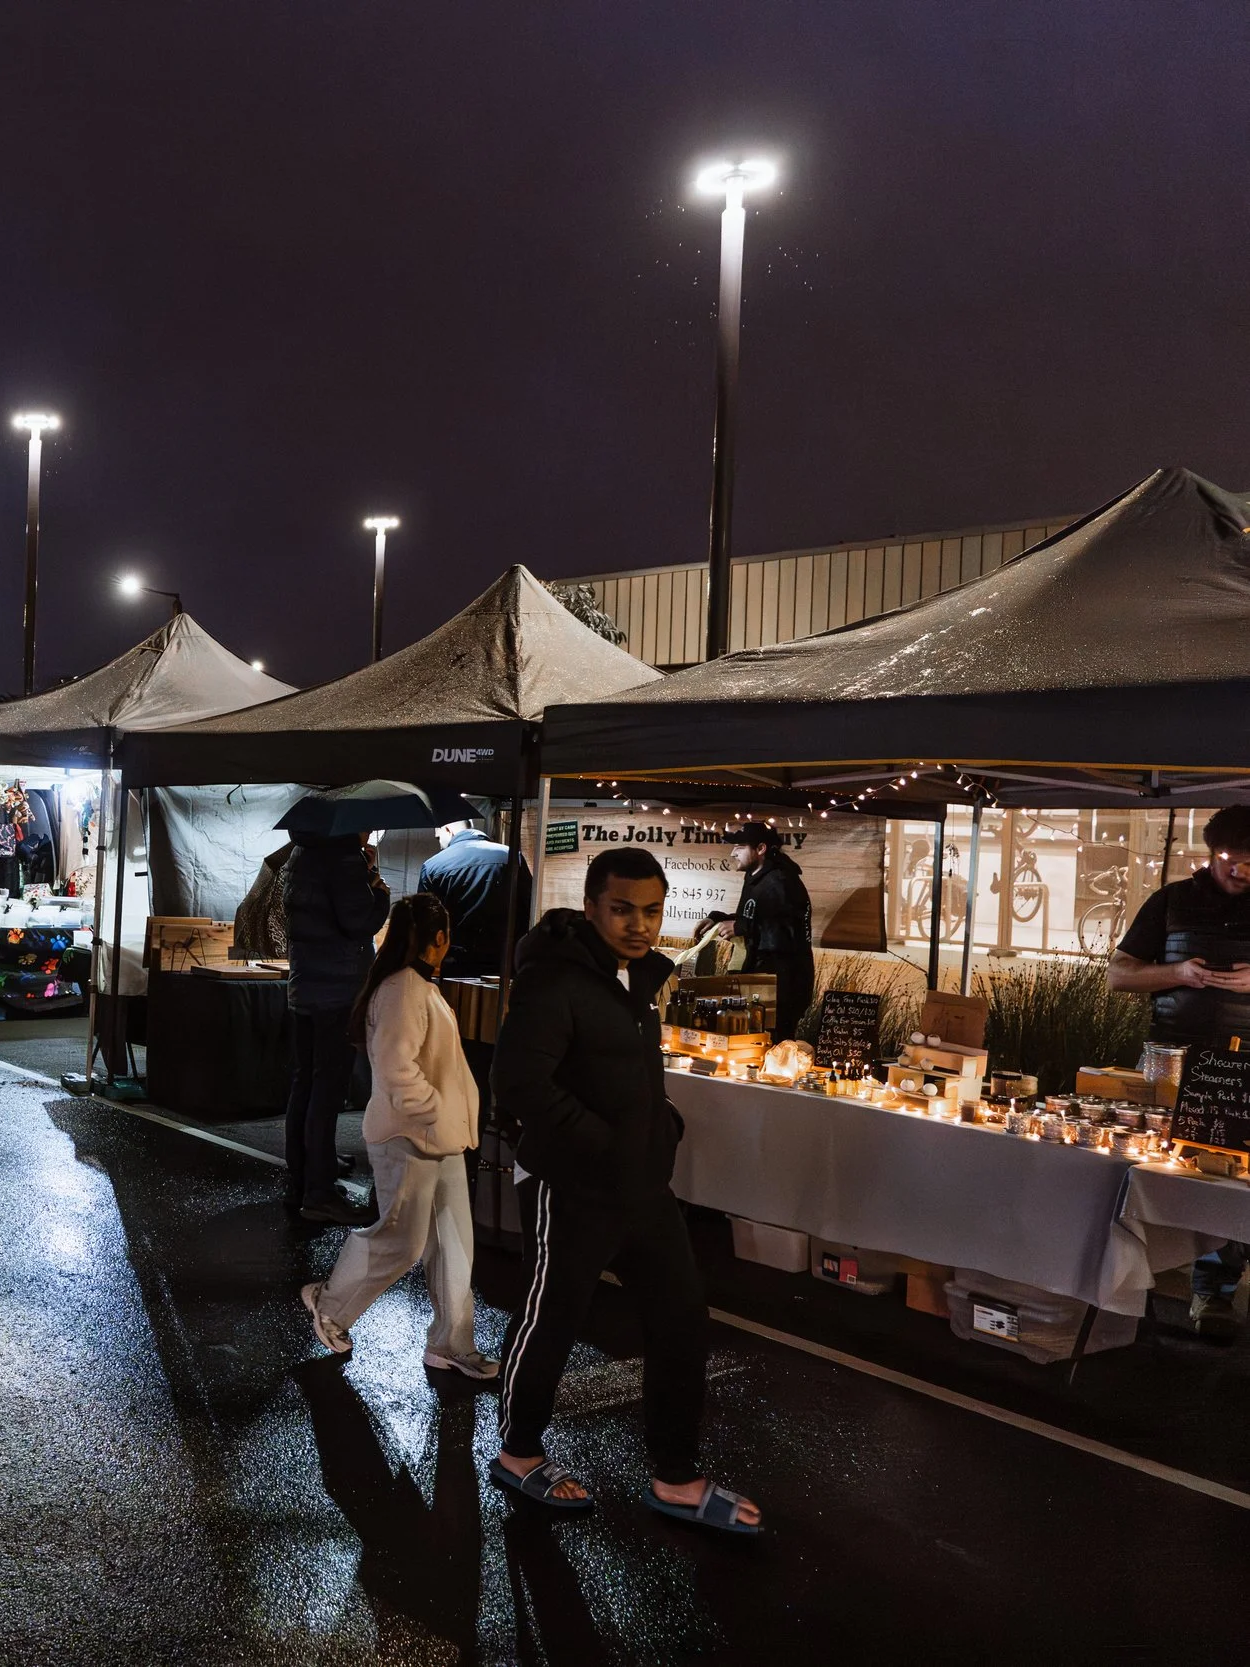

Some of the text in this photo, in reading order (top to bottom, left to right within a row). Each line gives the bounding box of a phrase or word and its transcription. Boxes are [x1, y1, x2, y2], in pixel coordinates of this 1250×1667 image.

[431, 748, 495, 763] DUNE 4WD
[582, 825, 808, 849] The Jolly Tim uy
[664, 857, 730, 871] Facebook &
[682, 887, 702, 900] 845
[706, 888, 726, 902] 937
[853, 1028, 865, 1036] $5
[816, 1045, 833, 1058] Body
[1198, 1050, 1250, 1070] Shower
[1190, 1066, 1243, 1087] Steamers
[1183, 1085, 1213, 1103] Sample
[1216, 1089, 1237, 1102] Pack
